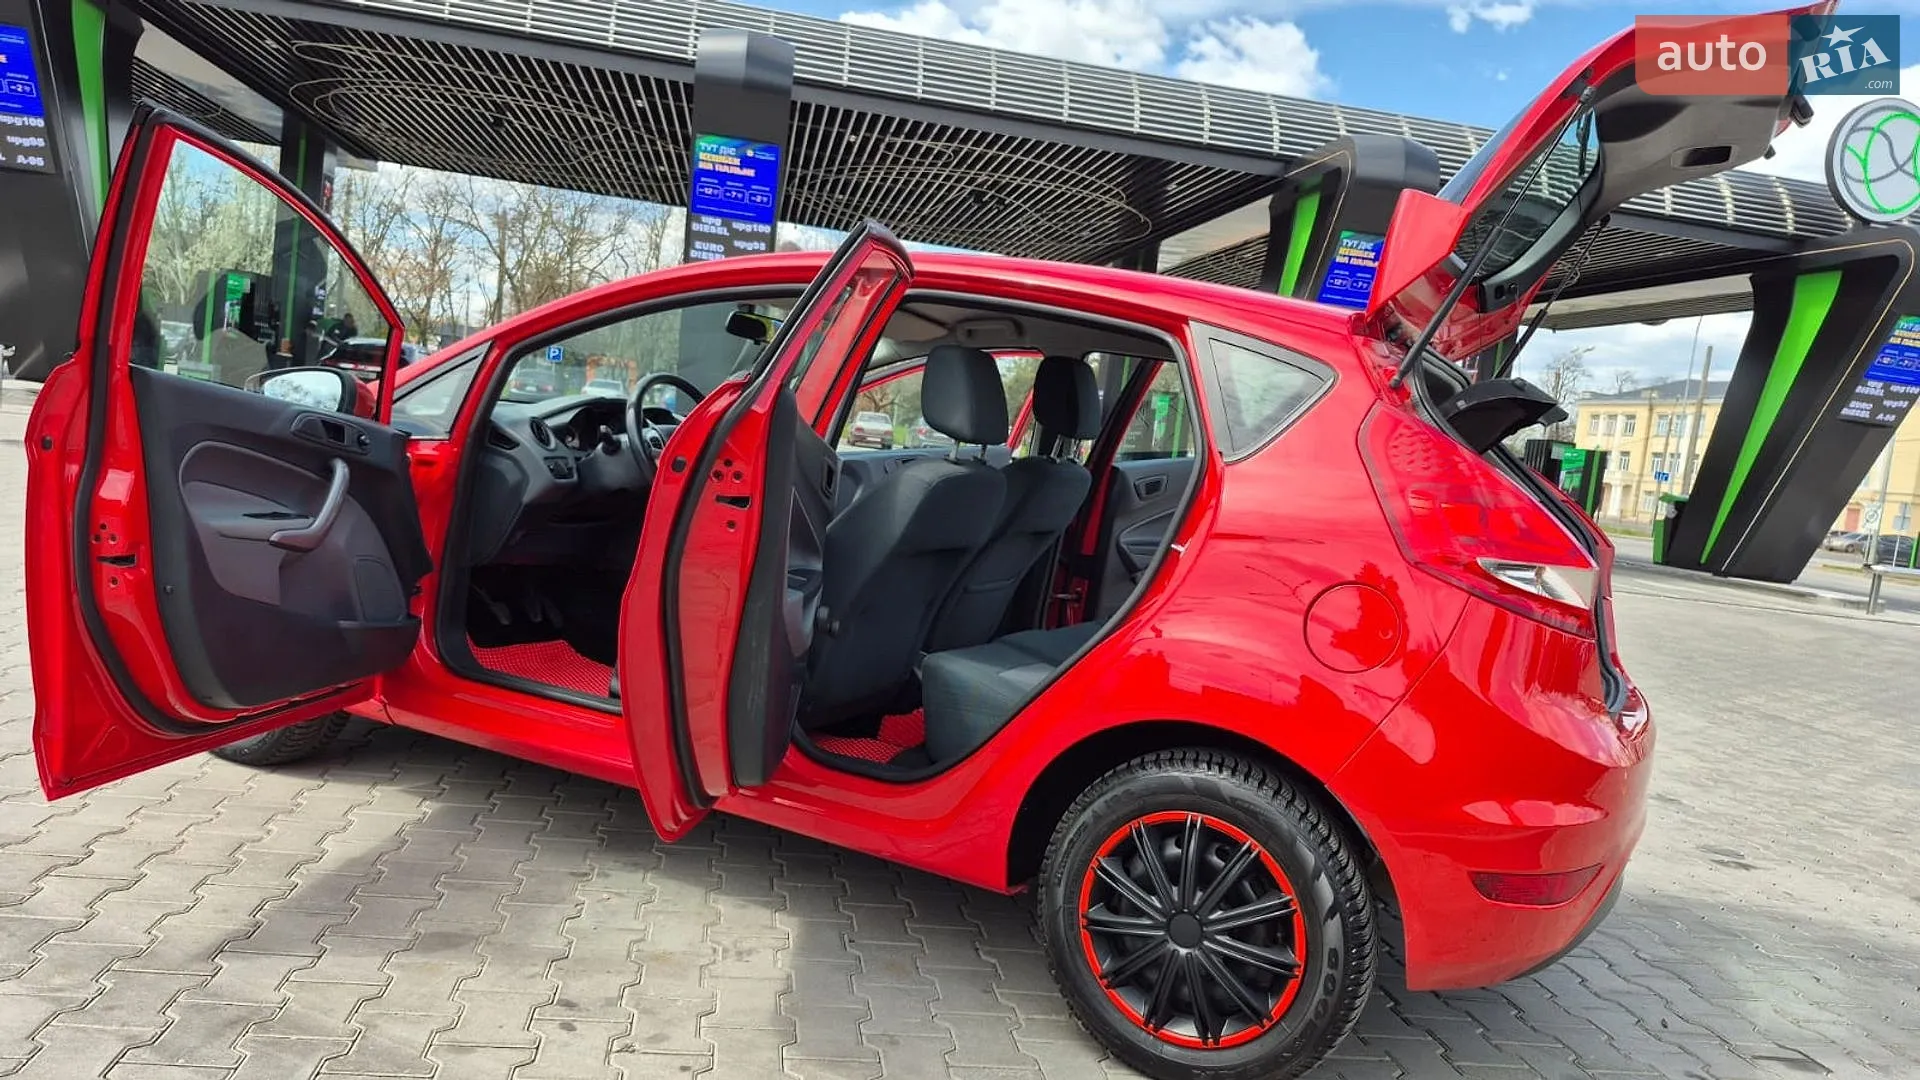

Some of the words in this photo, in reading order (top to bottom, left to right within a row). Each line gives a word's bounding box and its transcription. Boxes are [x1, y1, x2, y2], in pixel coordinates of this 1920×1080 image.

[701, 215, 722, 226] upg
[691, 221, 730, 236] DIESEL
[732, 221, 771, 233] upg100
[694, 240, 725, 253] EURO
